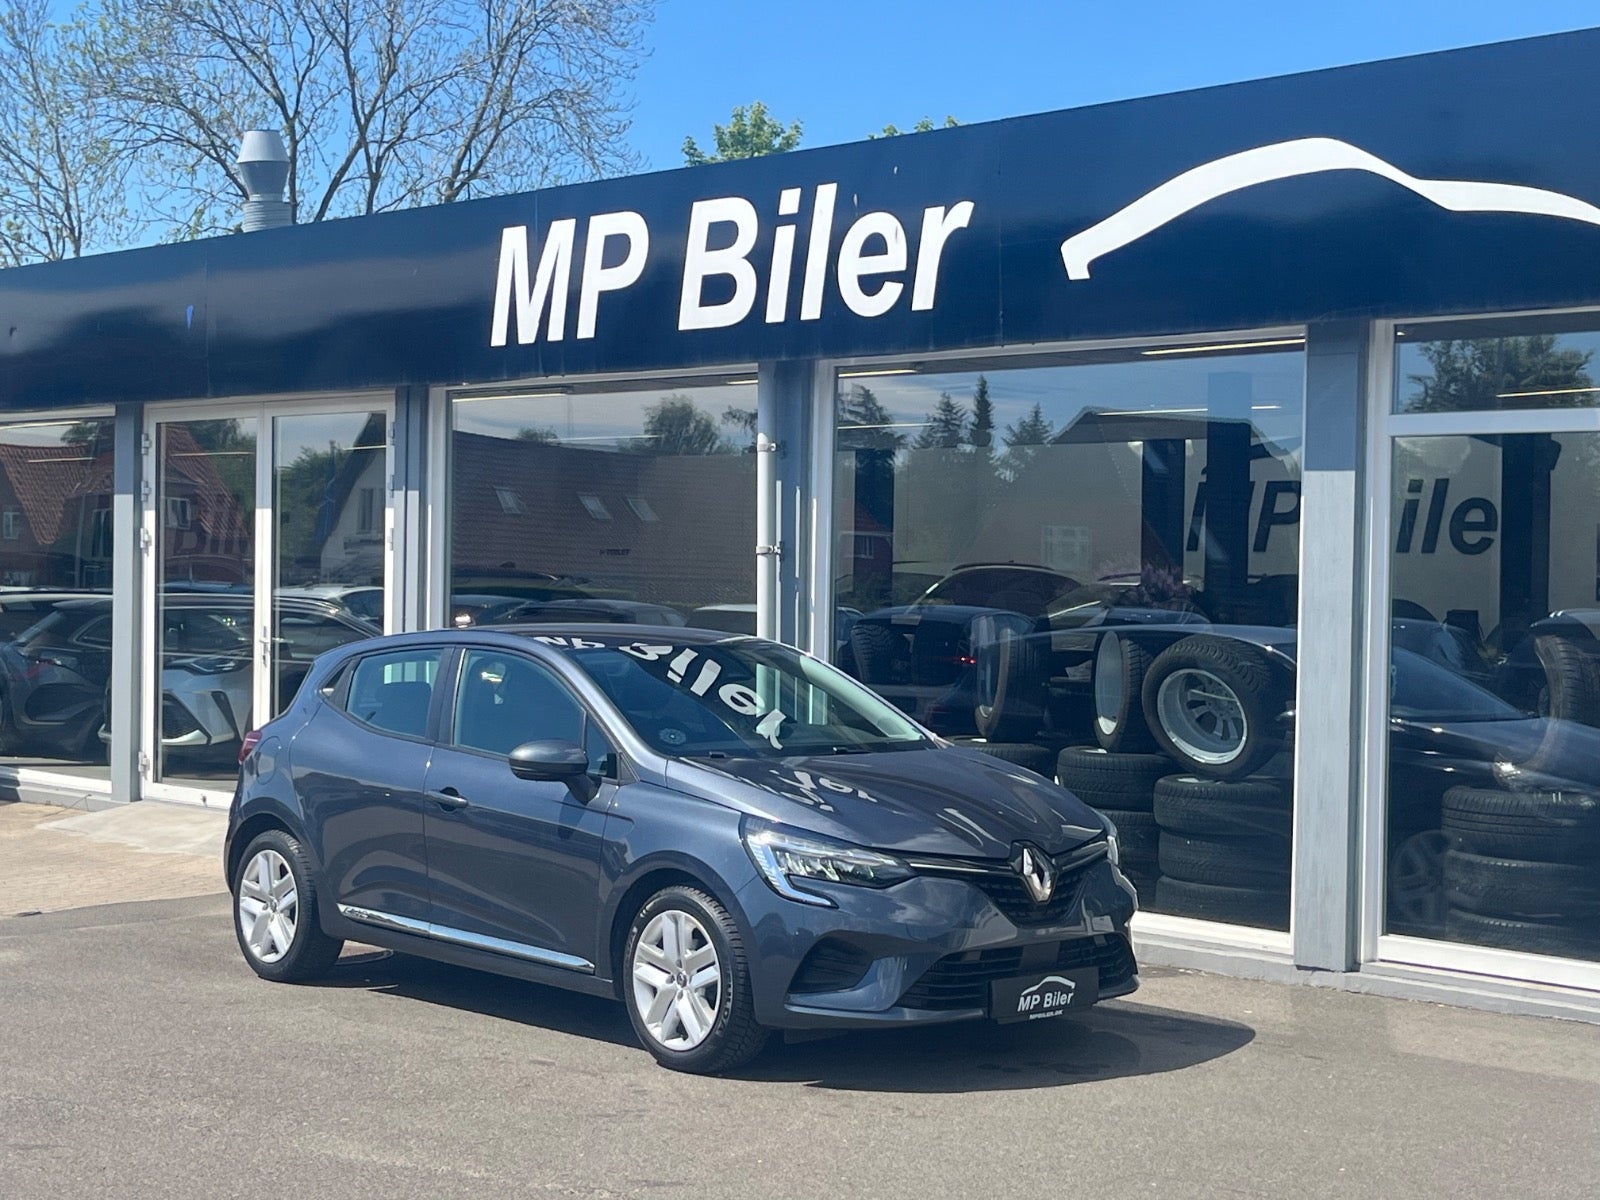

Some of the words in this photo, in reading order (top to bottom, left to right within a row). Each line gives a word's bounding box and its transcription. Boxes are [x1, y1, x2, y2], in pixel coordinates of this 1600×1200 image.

[490, 210, 650, 347] MP
[677, 182, 975, 331] Biler
[1396, 478, 1498, 556] ile
[1017, 994, 1041, 1012] MP
[1043, 990, 1074, 1008] Biler
